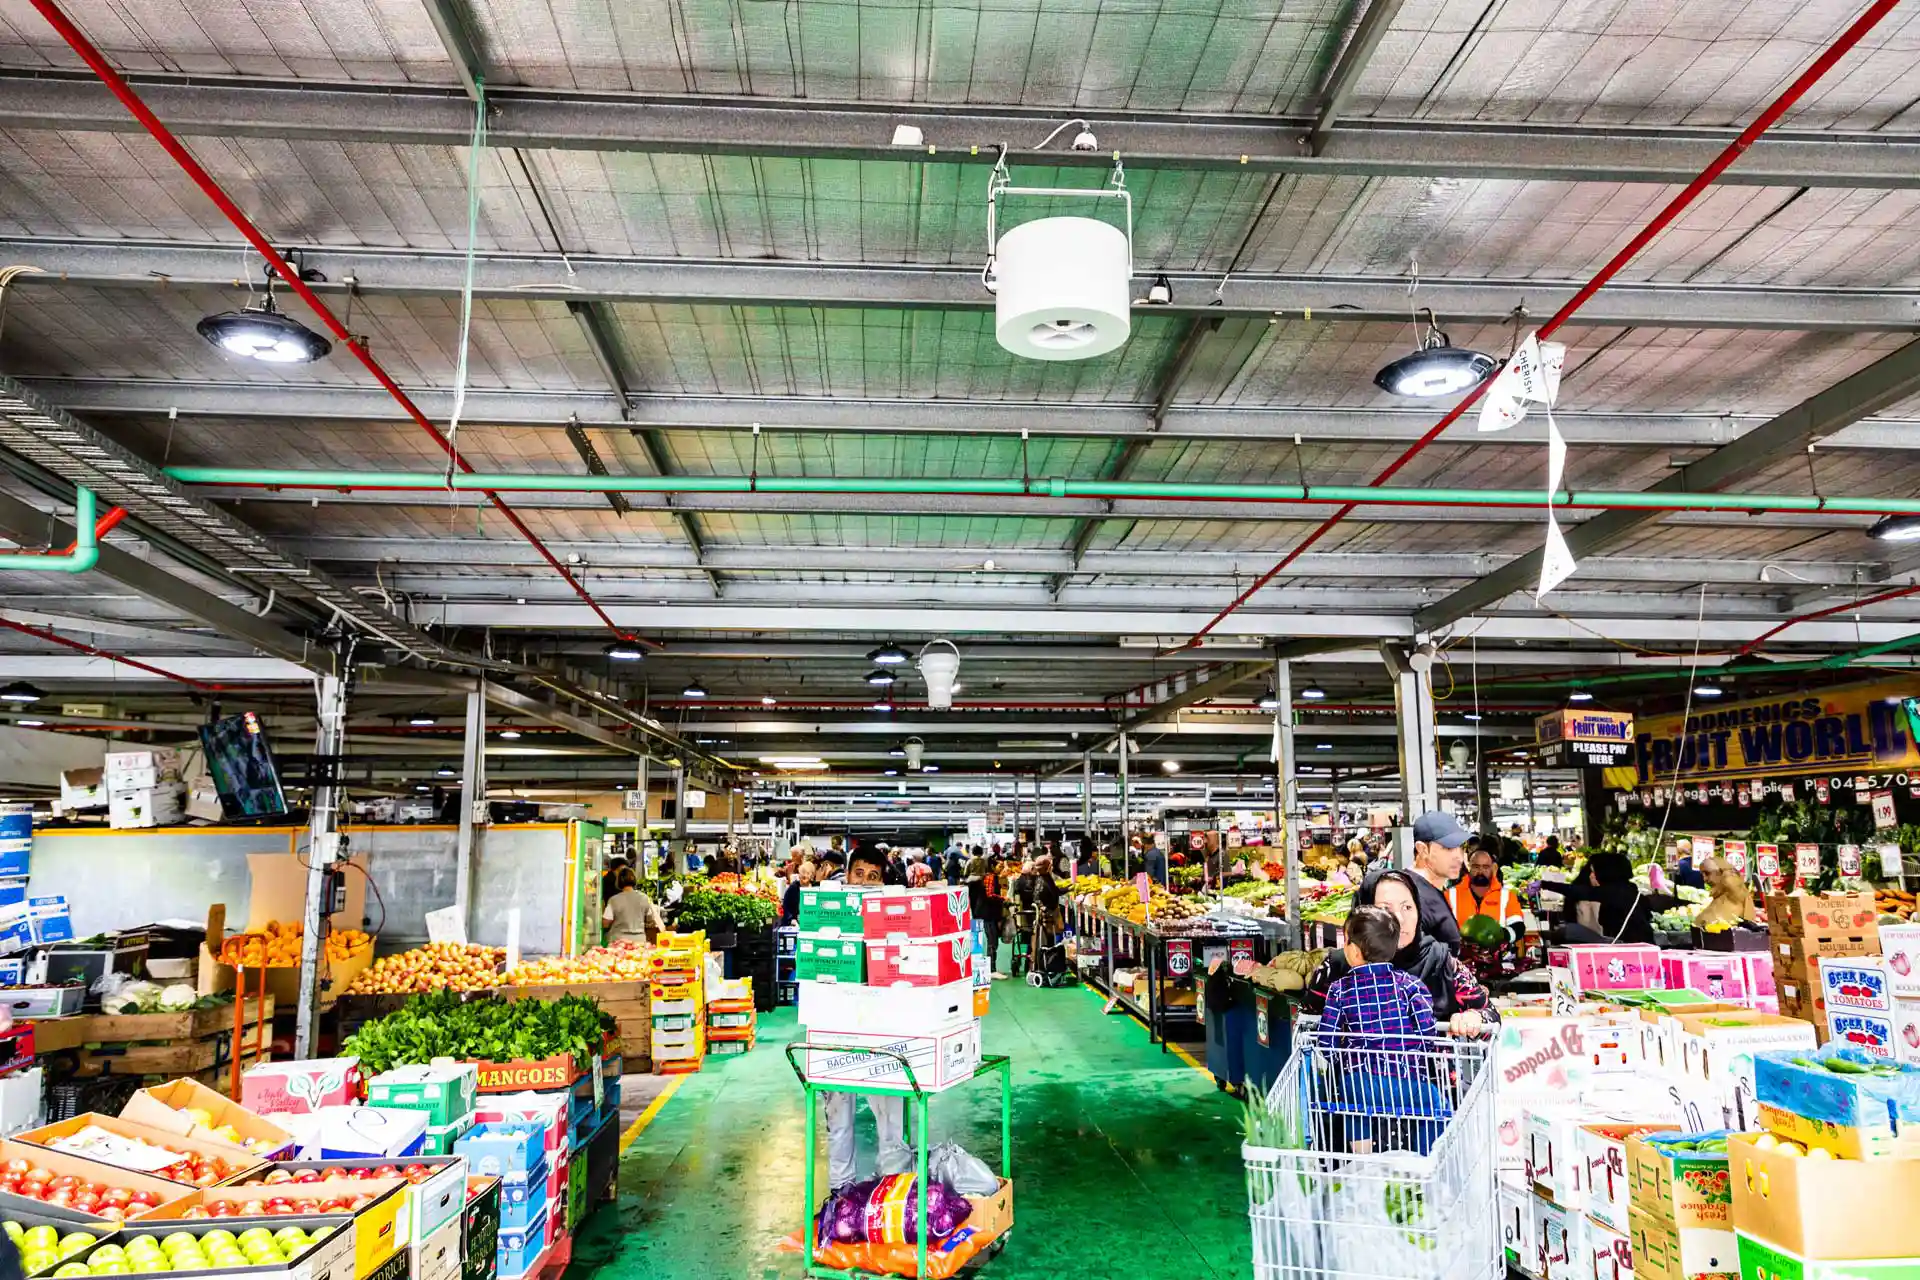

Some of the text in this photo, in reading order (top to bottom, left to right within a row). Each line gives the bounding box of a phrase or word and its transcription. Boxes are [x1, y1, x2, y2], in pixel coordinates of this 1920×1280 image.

[1519, 350, 1533, 394] CHERISH
[1686, 697, 1821, 733] DOMENICS
[1573, 719, 1594, 738] FRUIT
[1597, 721, 1627, 740] WORLD
[1573, 743, 1628, 755] PLEASE PAY
[1636, 698, 1907, 784] FRUIT WORLD
[1588, 754, 1614, 765] HERE
[1833, 995, 1884, 1009] TOMATOES
[826, 1052, 871, 1069] BACCHUS
[1503, 1036, 1565, 1083] Produce
[477, 1066, 566, 1088] MANGOES
[1696, 1211, 1727, 1221] Fresh
